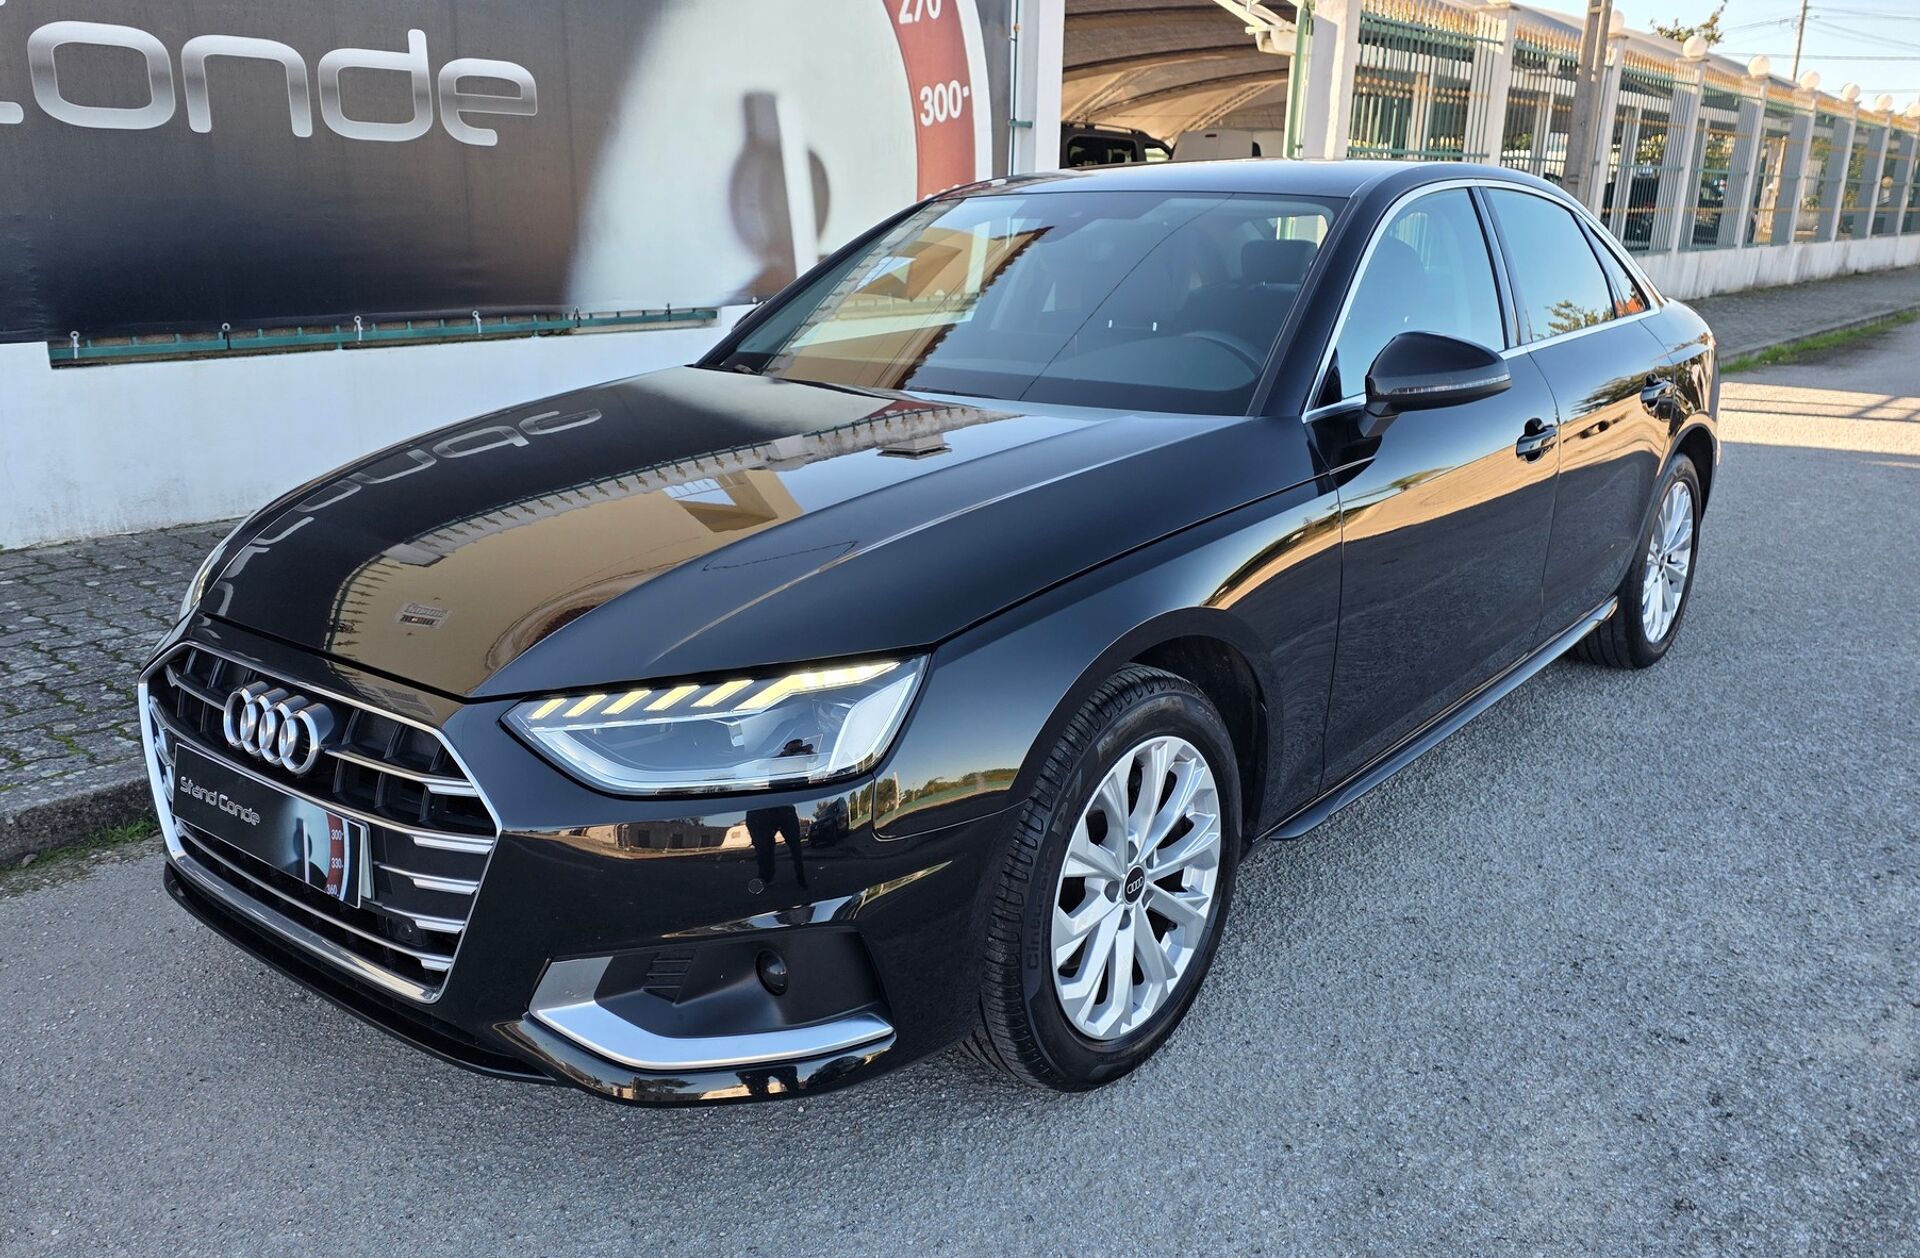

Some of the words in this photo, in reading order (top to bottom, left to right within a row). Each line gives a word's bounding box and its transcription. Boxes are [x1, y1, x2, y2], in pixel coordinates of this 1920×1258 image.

[0, 0, 538, 147] onde
[920, 79, 963, 127] 300
[179, 776, 218, 806] Stand
[218, 793, 261, 827] Conde
